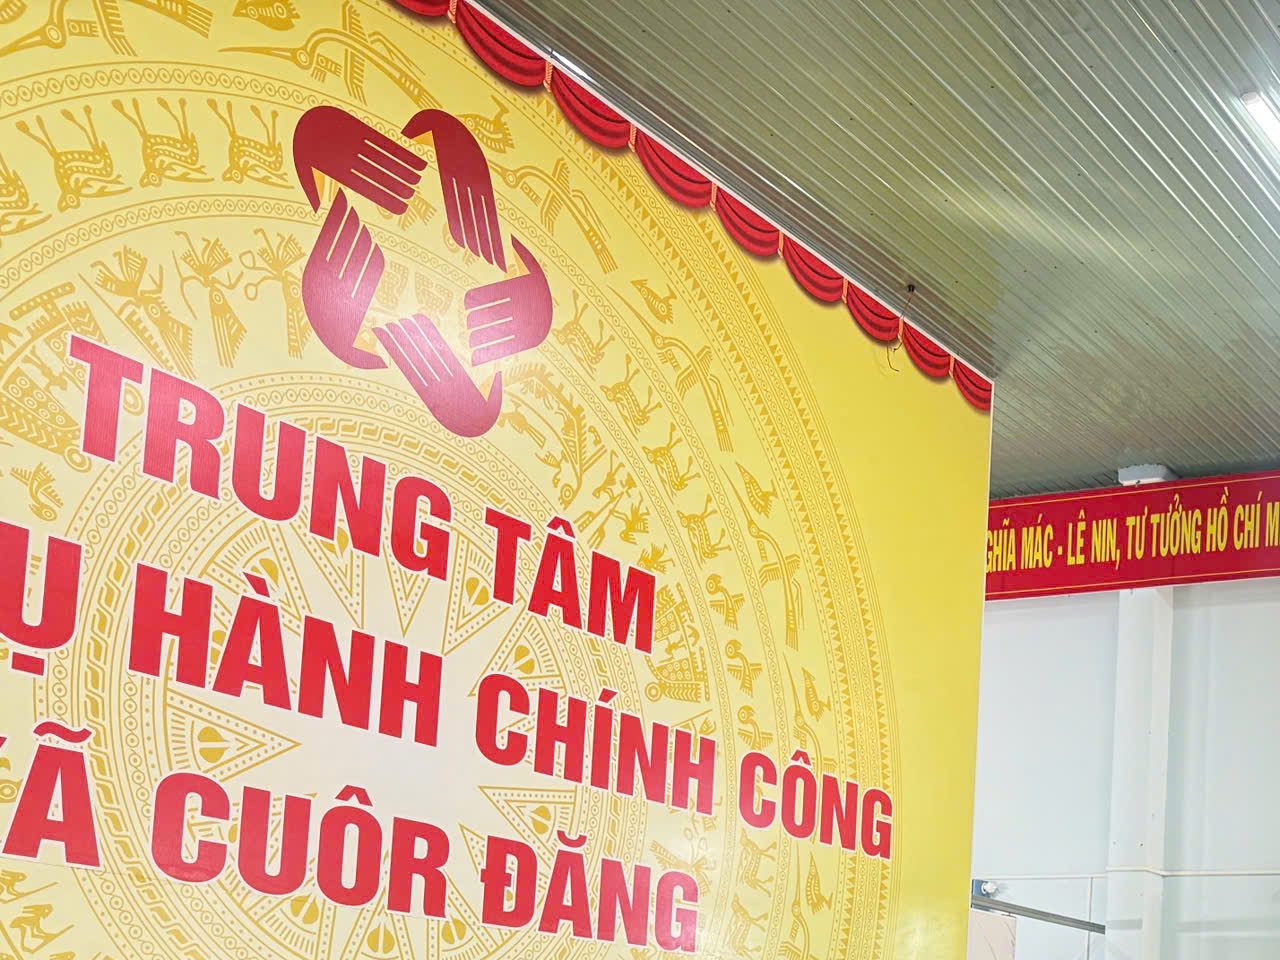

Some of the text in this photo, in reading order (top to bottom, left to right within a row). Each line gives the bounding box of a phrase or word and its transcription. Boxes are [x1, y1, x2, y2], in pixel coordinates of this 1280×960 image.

[69, 334, 656, 654] TRUNG TÂM
[1021, 513, 1053, 570] MÁC
[1057, 545, 1063, 555] -
[1067, 510, 1085, 565] LÊ
[1091, 518, 1120, 571] NIN,
[1126, 505, 1148, 560] TƯ
[1151, 494, 1201, 558] TƯỞNG
[1206, 487, 1229, 553] HỒ
[1233, 491, 1262, 550] CHÍ
[0, 721, 699, 953] Ã CUÔR ĐĂNG
[129, 563, 443, 747] HÀNH
[475, 673, 716, 816] CHÍNH
[738, 749, 893, 859] CÔNG
